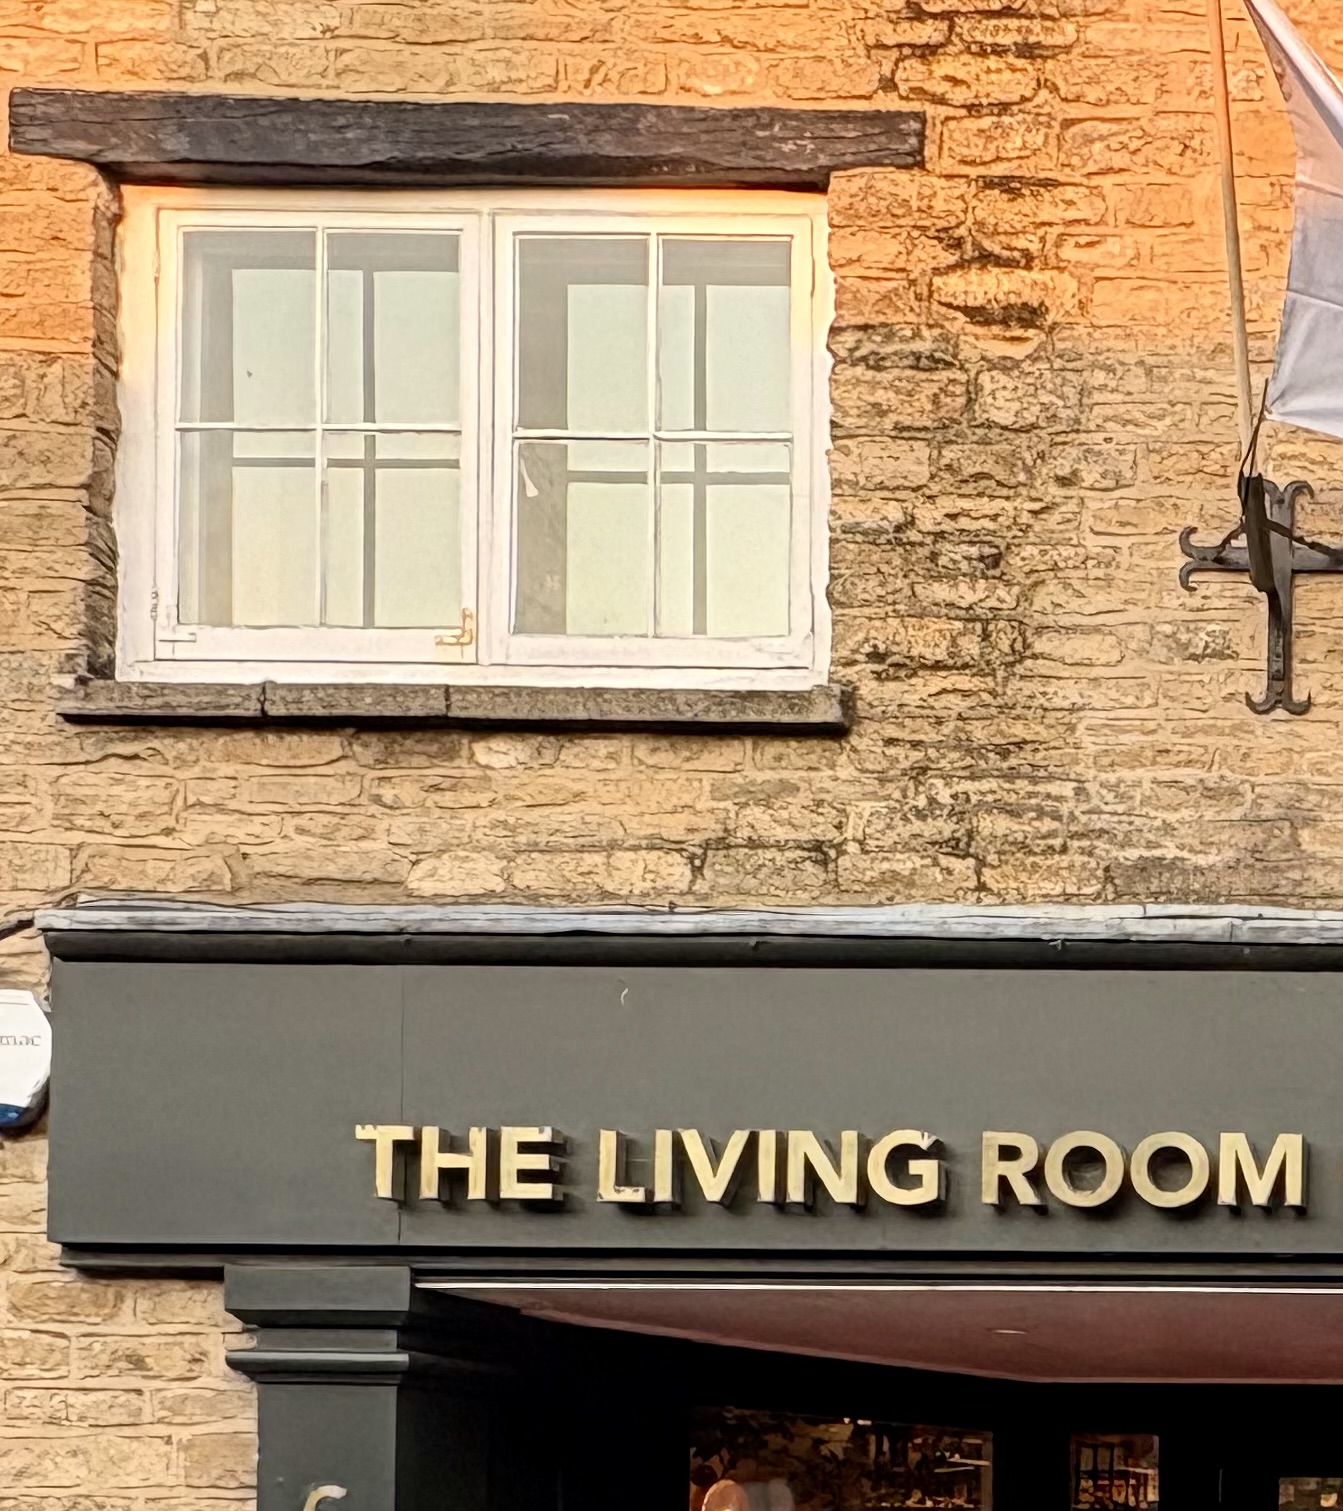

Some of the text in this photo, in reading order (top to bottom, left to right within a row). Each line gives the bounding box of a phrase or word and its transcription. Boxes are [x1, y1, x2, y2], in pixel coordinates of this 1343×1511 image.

[355, 1124, 553, 1200] THE
[597, 1128, 940, 1206] LIVING
[982, 1130, 1306, 1209] ROOM
